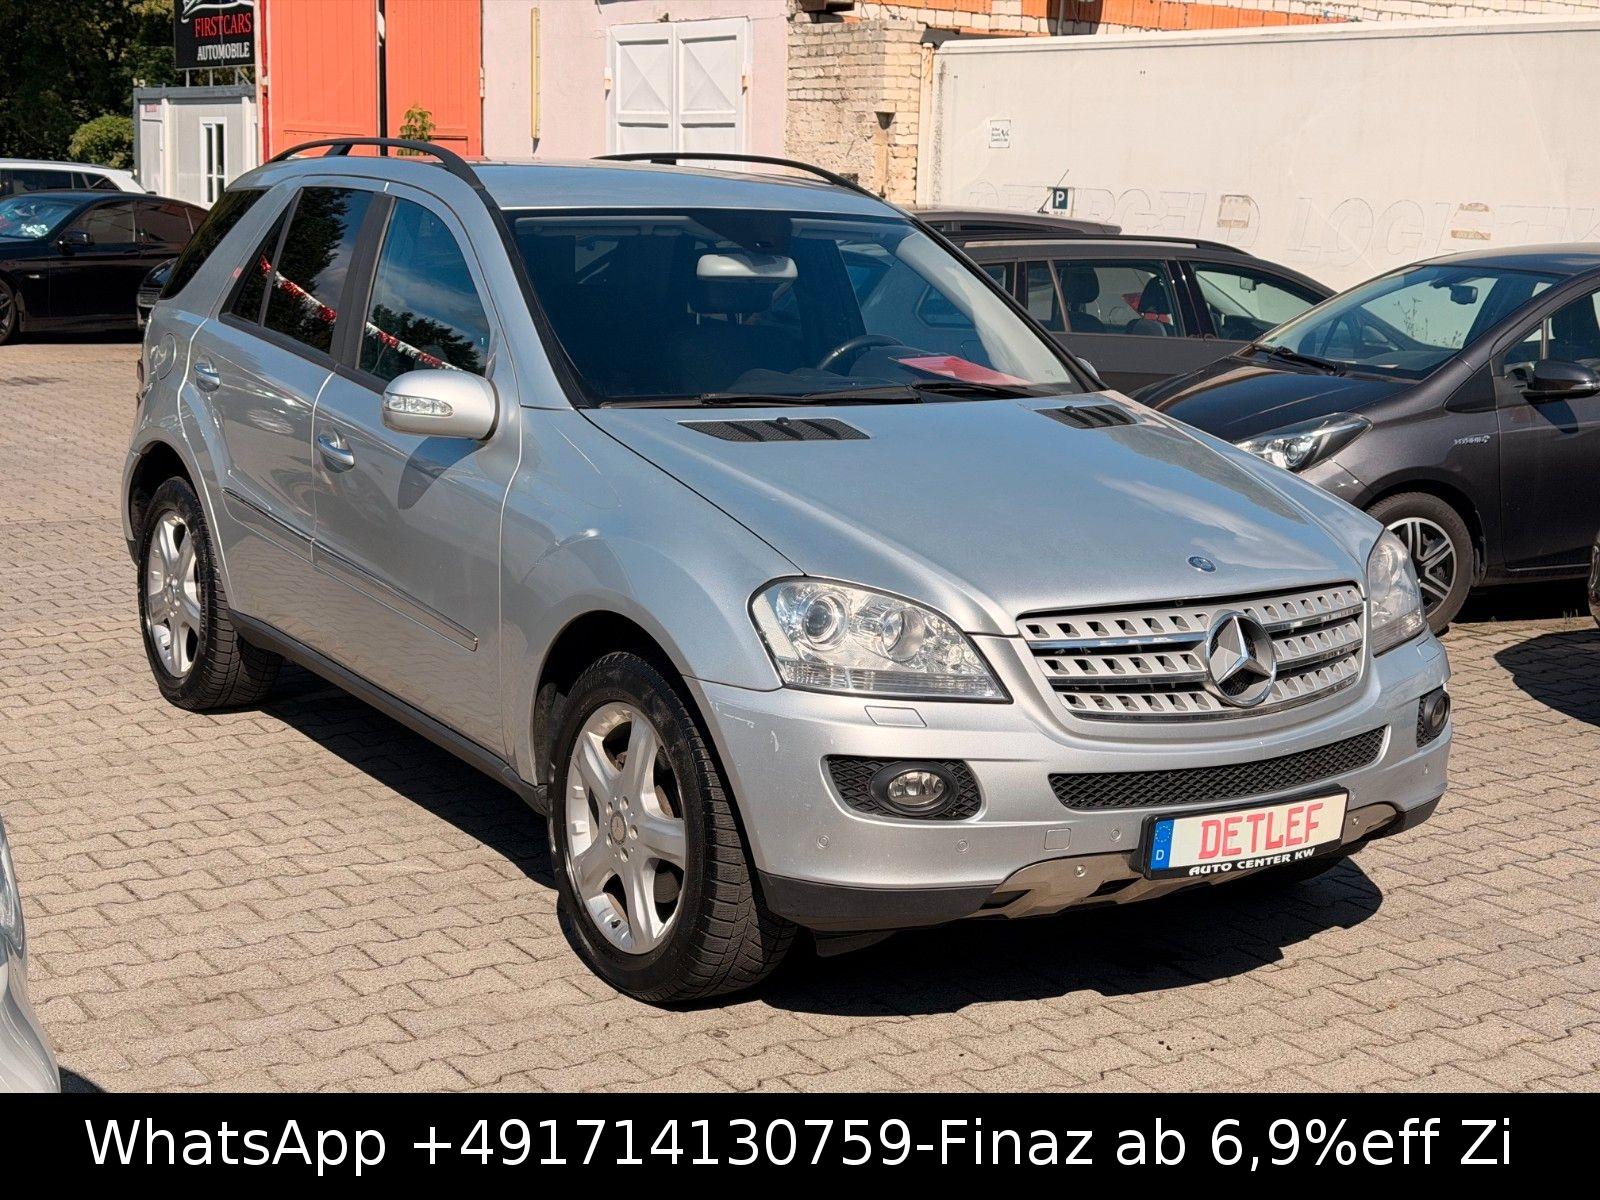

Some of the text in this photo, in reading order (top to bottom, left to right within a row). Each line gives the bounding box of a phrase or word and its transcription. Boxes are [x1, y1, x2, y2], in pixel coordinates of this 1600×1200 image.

[194, 12, 252, 38] FIRSTCARS
[196, 41, 250, 61] AUTOMOBILE
[1055, 190, 1066, 207] P
[1198, 802, 1324, 860] DETLEF
[1155, 849, 1165, 861] D
[1188, 847, 1316, 877] AUTO CENTER KW
